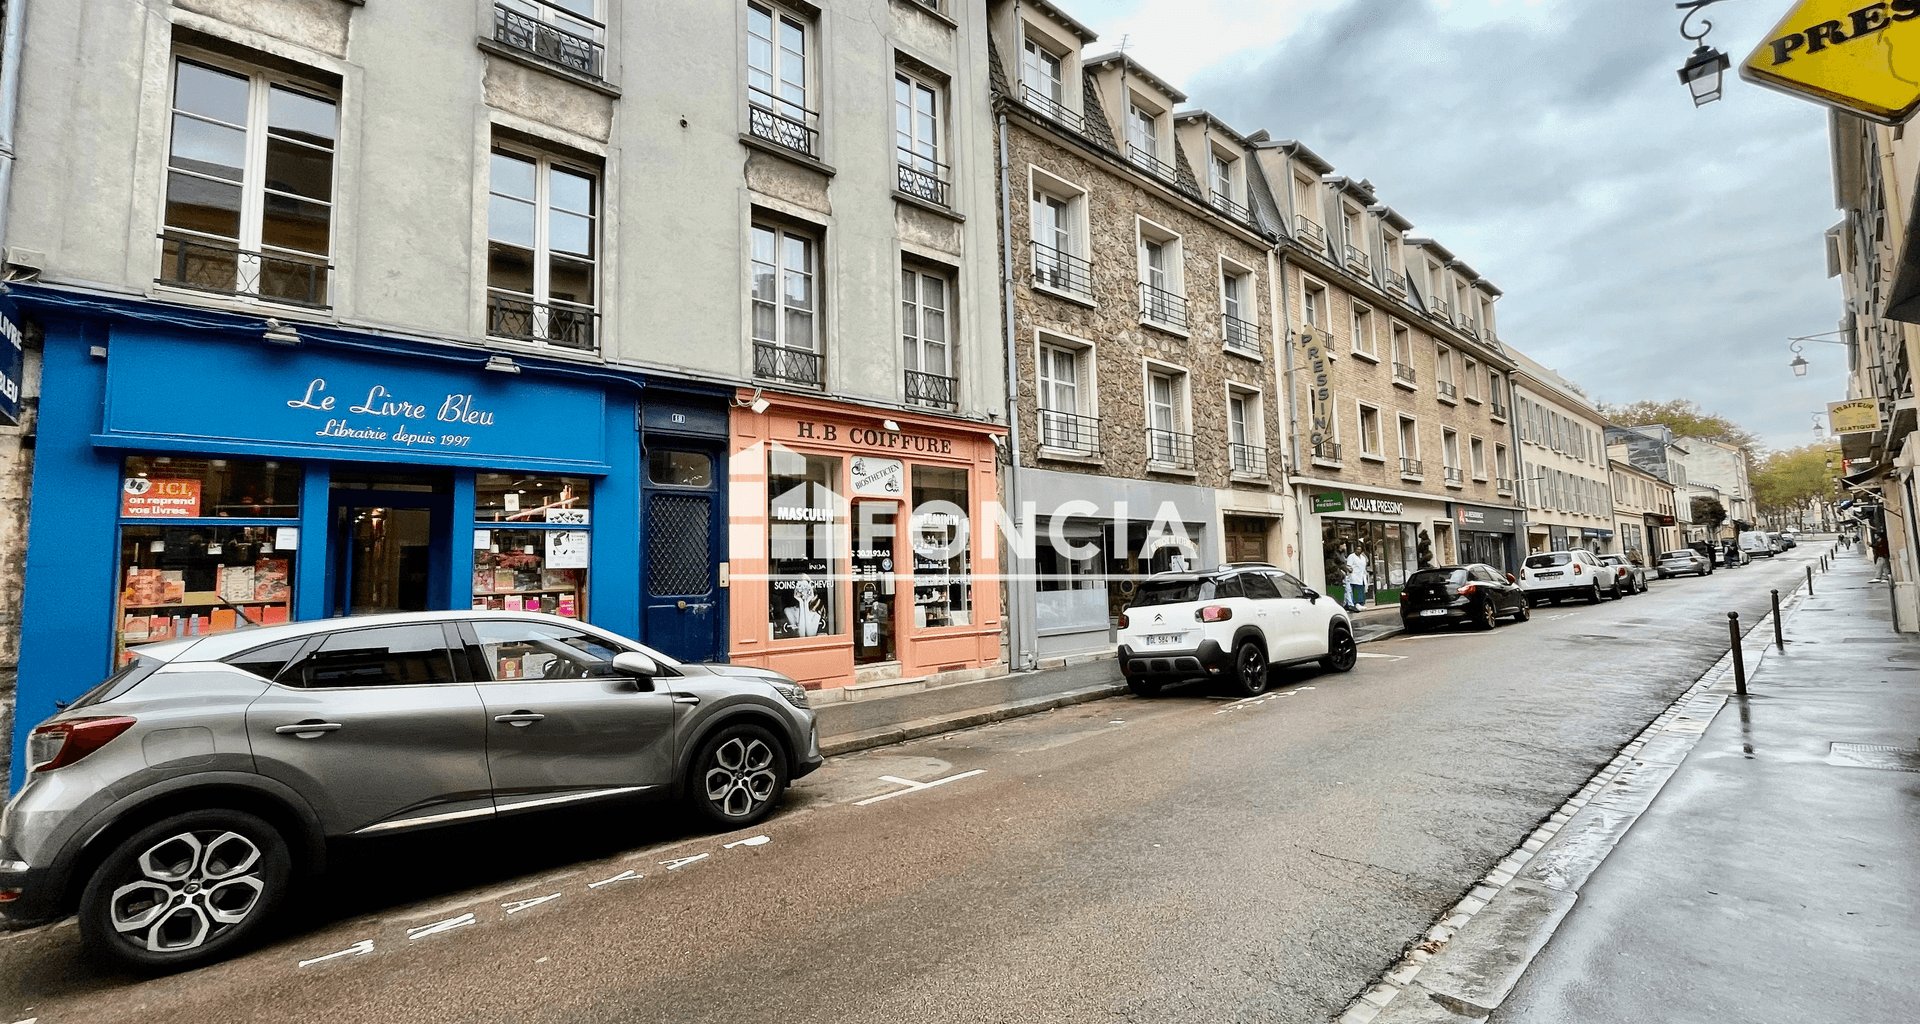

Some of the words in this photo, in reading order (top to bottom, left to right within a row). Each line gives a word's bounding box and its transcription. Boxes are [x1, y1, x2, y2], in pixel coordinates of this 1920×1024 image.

[1302, 333, 1329, 445] PRESSING
[287, 378, 336, 411] Le
[349, 385, 426, 419] Livre
[437, 394, 494, 426] Bleu
[1832, 402, 1875, 414] TRAITEUR
[315, 419, 387, 441] Librairie
[392, 424, 436, 446] depuis
[440, 434, 471, 447] 1997
[1834, 423, 1876, 432] ASIATIQUE
[797, 420, 837, 441] H.B
[849, 427, 951, 455] COIFFURE
[157, 482, 193, 497] ICI,
[147, 496, 196, 506] reprend
[1349, 497, 1372, 511] KOALA
[1377, 501, 1404, 514] PRESSING
[152, 506, 190, 515] livres.
[777, 507, 834, 522] MASCULIN
[774, 580, 796, 590] SOINS
